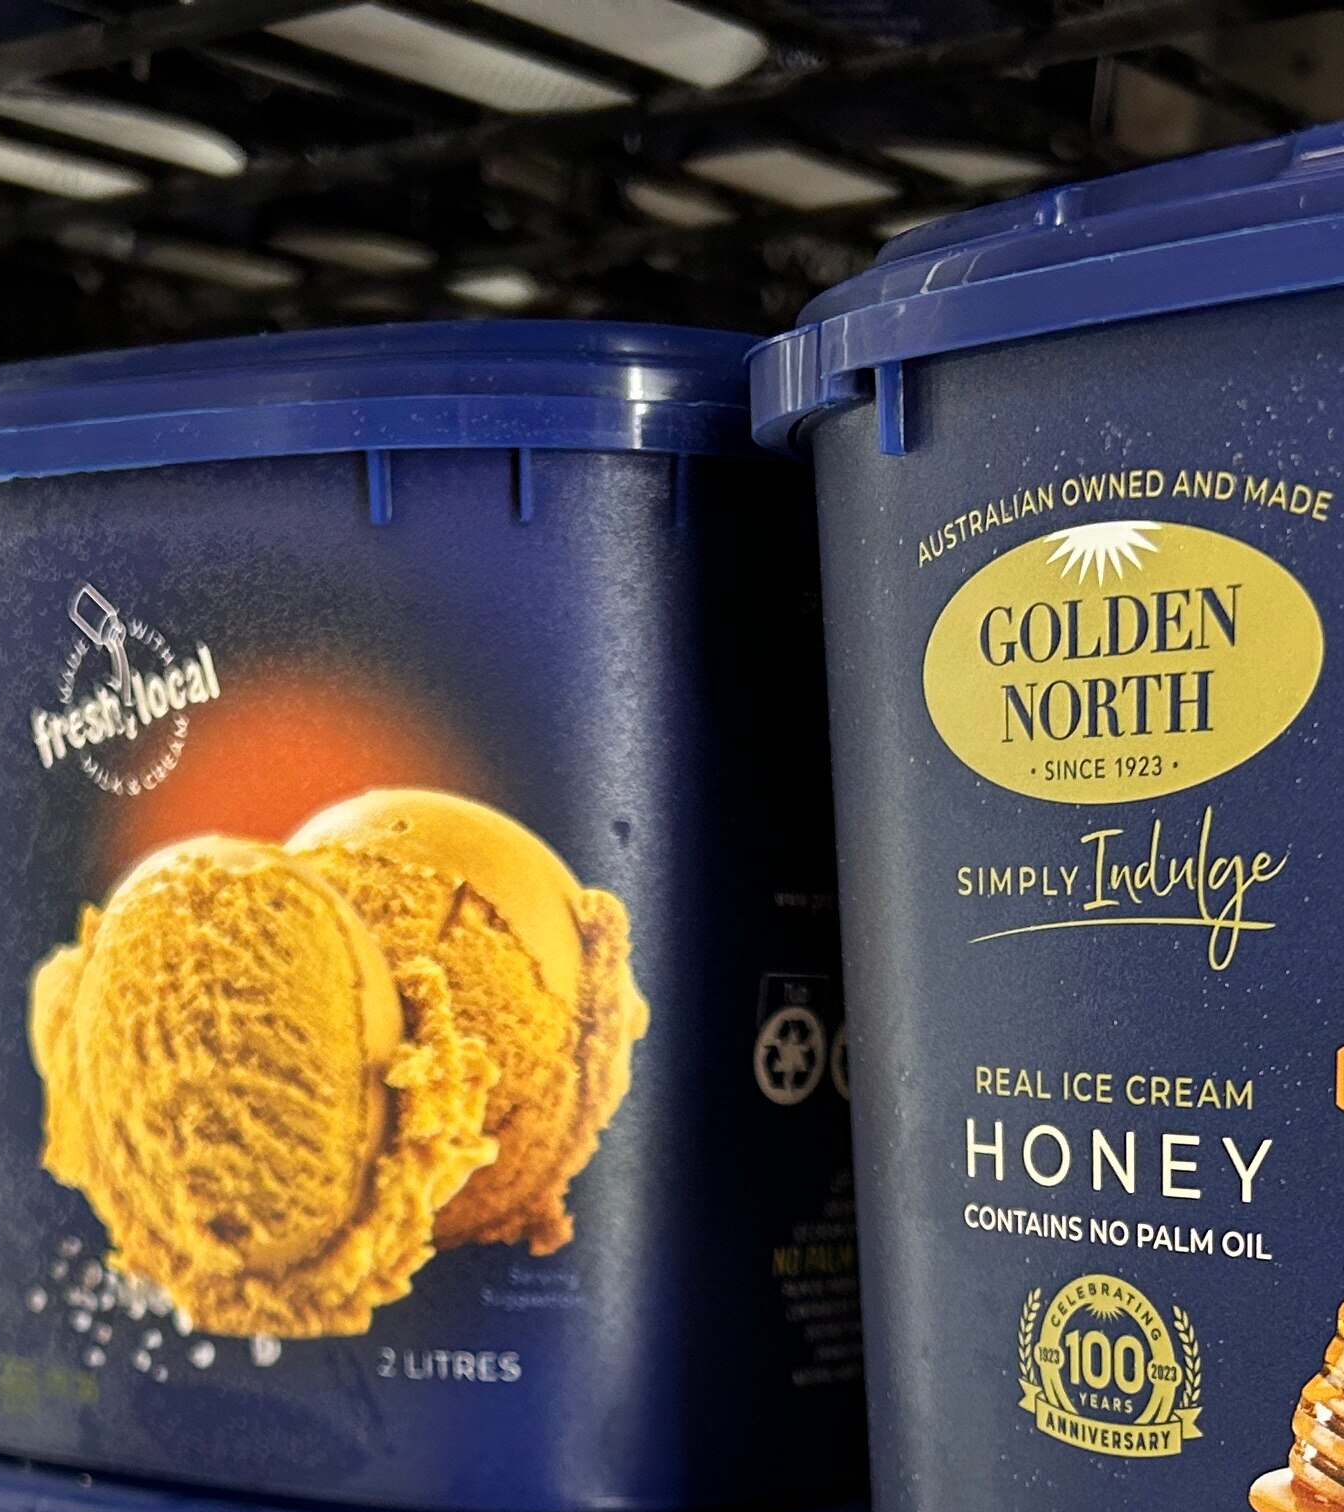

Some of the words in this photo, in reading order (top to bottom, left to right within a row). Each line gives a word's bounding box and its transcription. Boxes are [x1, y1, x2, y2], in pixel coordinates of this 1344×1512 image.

[916, 484, 1055, 568] AUSTRALIAN
[1060, 470, 1164, 506] OWNED
[1172, 468, 1237, 500] AND
[1242, 475, 1334, 522] MADE
[978, 584, 1242, 667] GOLDEN
[31, 680, 125, 769] fresh
[130, 639, 221, 726] local
[1001, 670, 1215, 744] NORTH
[1044, 756, 1106, 781] SINCE
[1114, 754, 1164, 779] 1923
[957, 865, 1079, 898] SIMPLY
[1080, 806, 1288, 970] Indulge
[975, 1066, 1051, 1100] REAL
[1062, 1072, 1113, 1104] ICE
[1126, 1077, 1254, 1110] CREAM
[963, 1118, 1272, 1203] HONEY
[963, 1204, 1083, 1242] CONTAINS
[1089, 1218, 1129, 1246] NO
[1136, 1224, 1213, 1255] PALM
[1221, 1230, 1271, 1260] OIL
[1051, 1282, 1161, 1341] CELEBRATING
[376, 1346, 398, 1380] 2
[402, 1350, 522, 1383] LITRES
[1065, 1330, 1144, 1394] 100
[1151, 1364, 1177, 1383] 2023
[1046, 1411, 1171, 1451] ANNIVERSARY
[1079, 1392, 1133, 1414] YEARS
